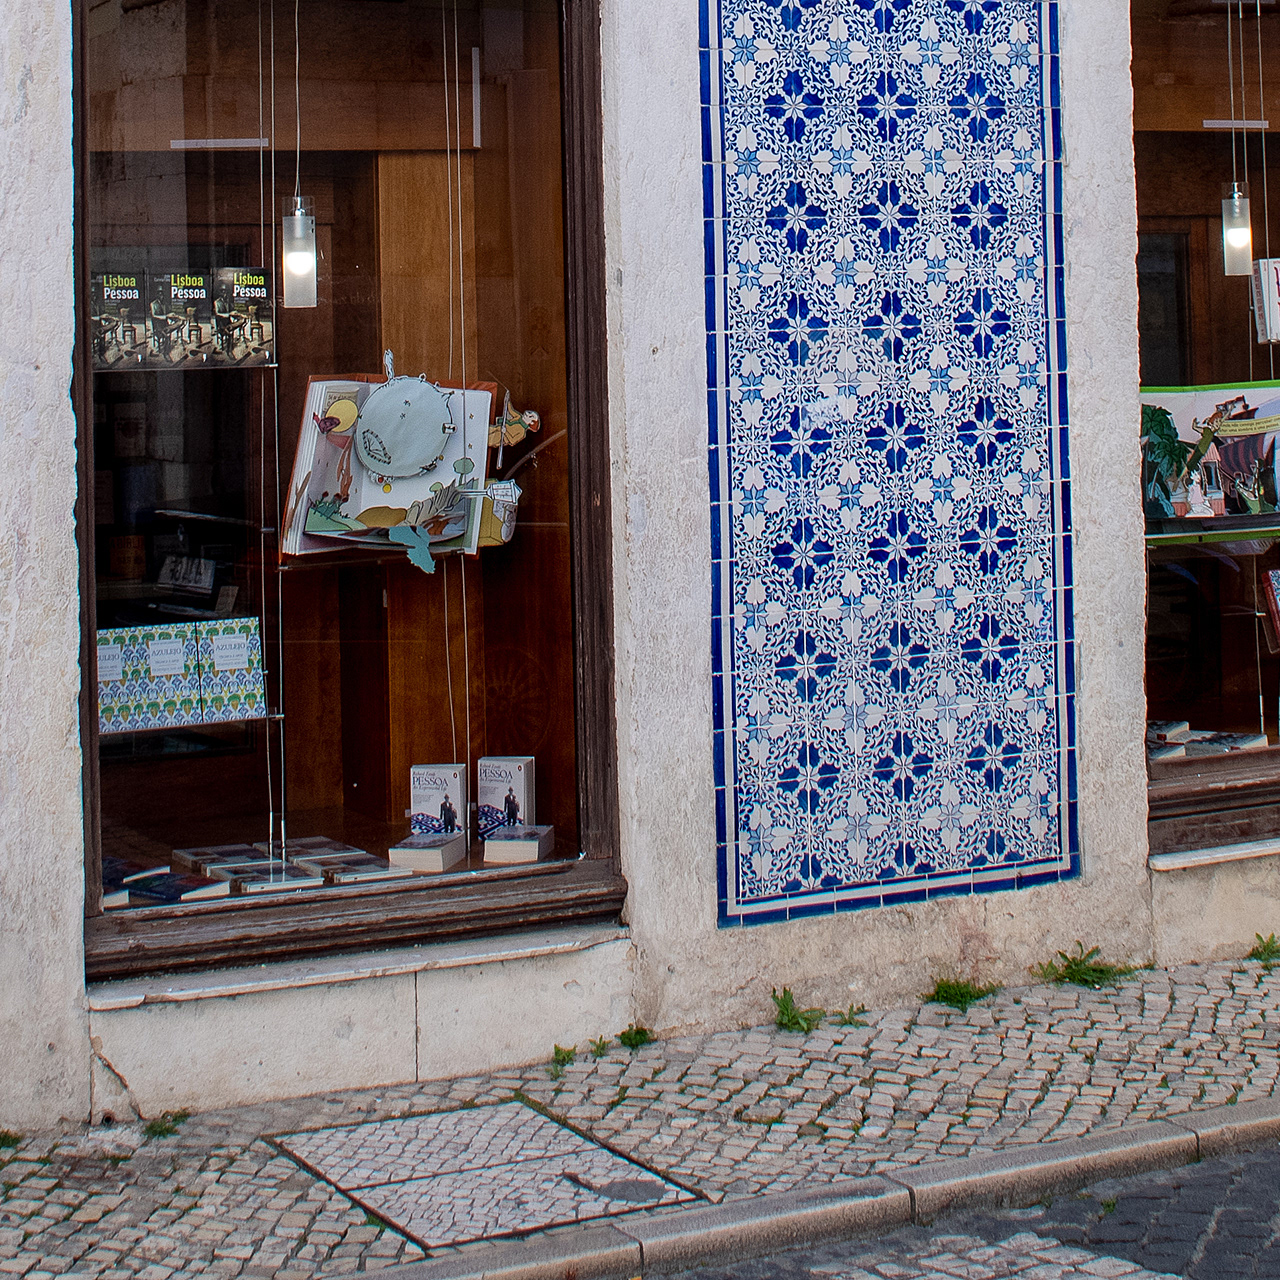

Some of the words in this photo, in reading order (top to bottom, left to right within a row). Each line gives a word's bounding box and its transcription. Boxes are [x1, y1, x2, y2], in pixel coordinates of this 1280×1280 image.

[103, 275, 136, 287] Lisboa
[171, 274, 204, 286] Lisboa
[233, 272, 264, 285] Lisboa
[103, 287, 139, 299] Pessoa
[171, 286, 206, 299] Pessoa
[233, 285, 267, 297] Pessoa
[152, 648, 181, 656] AZULEJO
[216, 643, 246, 651] AZULEJO
[98, 653, 120, 661] ULEJO
[479, 768, 513, 779] PESSOA
[413, 776, 449, 787] PESSOA
